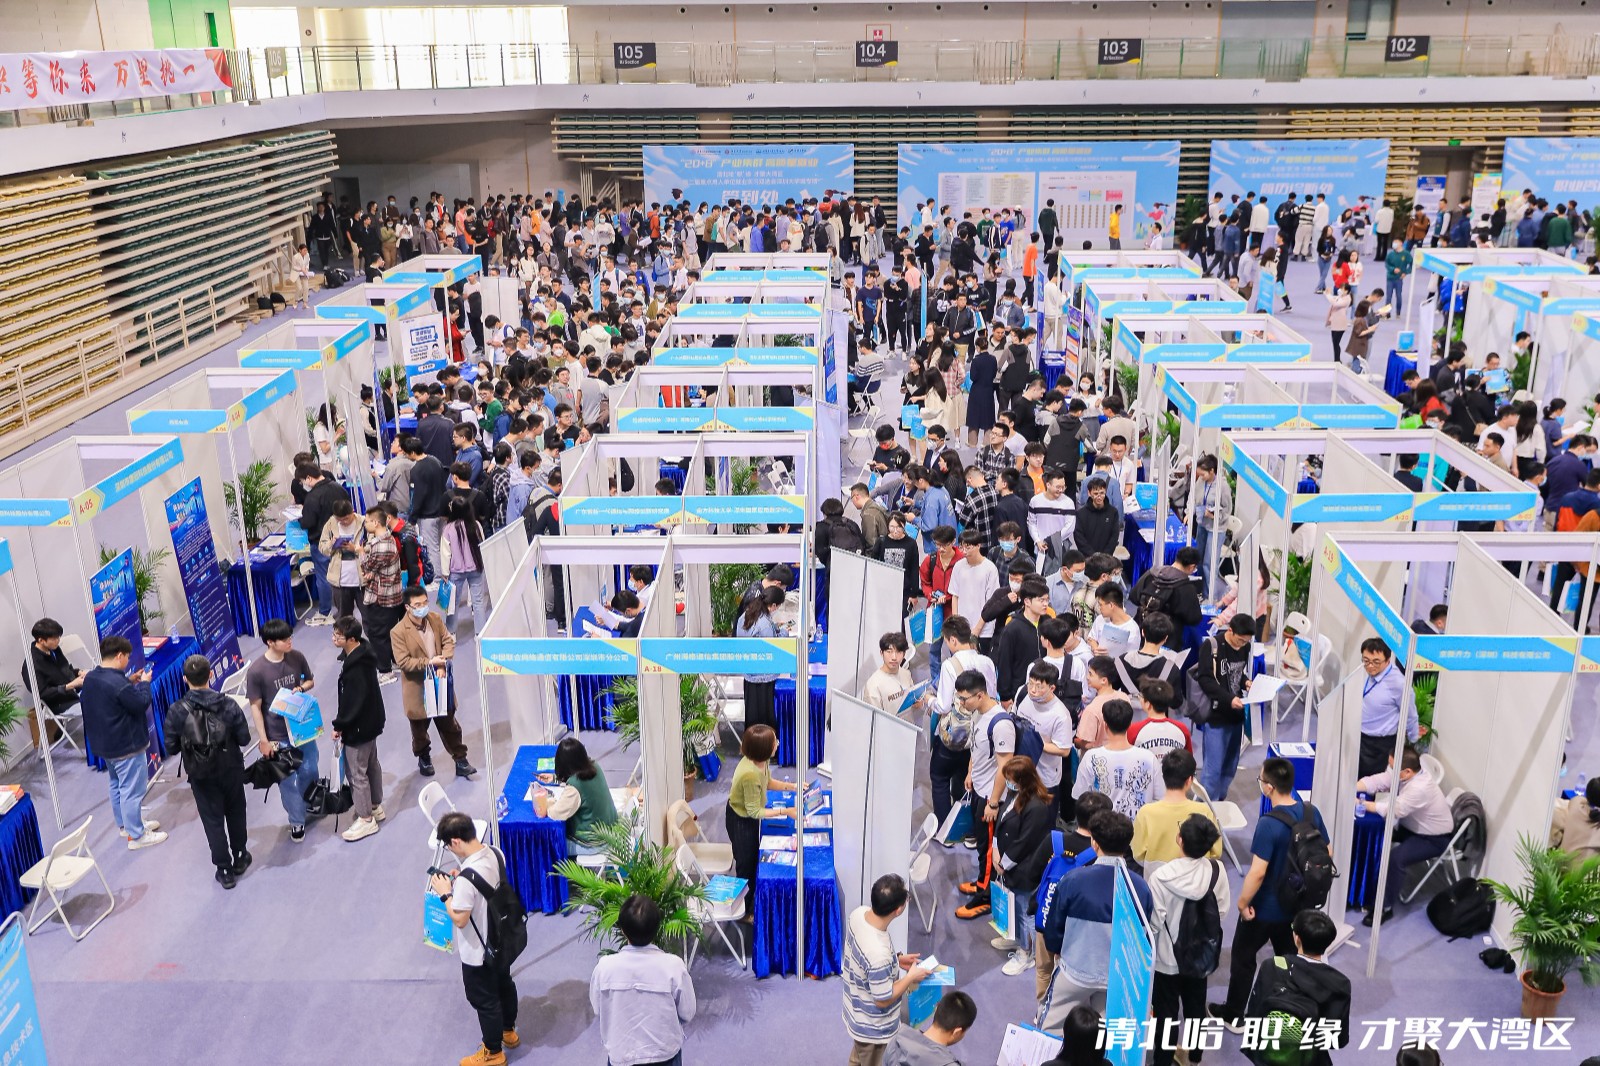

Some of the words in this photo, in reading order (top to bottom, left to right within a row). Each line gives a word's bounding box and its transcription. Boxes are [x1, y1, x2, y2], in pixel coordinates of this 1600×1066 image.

[617, 45, 644, 59] 105
[860, 43, 886, 58] 104
[1103, 40, 1129, 55] 103
[1390, 37, 1417, 52] 102
[113, 57, 196, 89] 万里挑一
[1553, 179, 1600, 193] 职业咨
[721, 189, 779, 206] 签到处
[79, 498, 94, 515] A-05
[644, 665, 662, 673] A-18
[1415, 662, 1434, 670] A-19
[1580, 663, 1599, 671] B-03
[273, 673, 296, 689] TETRIS
